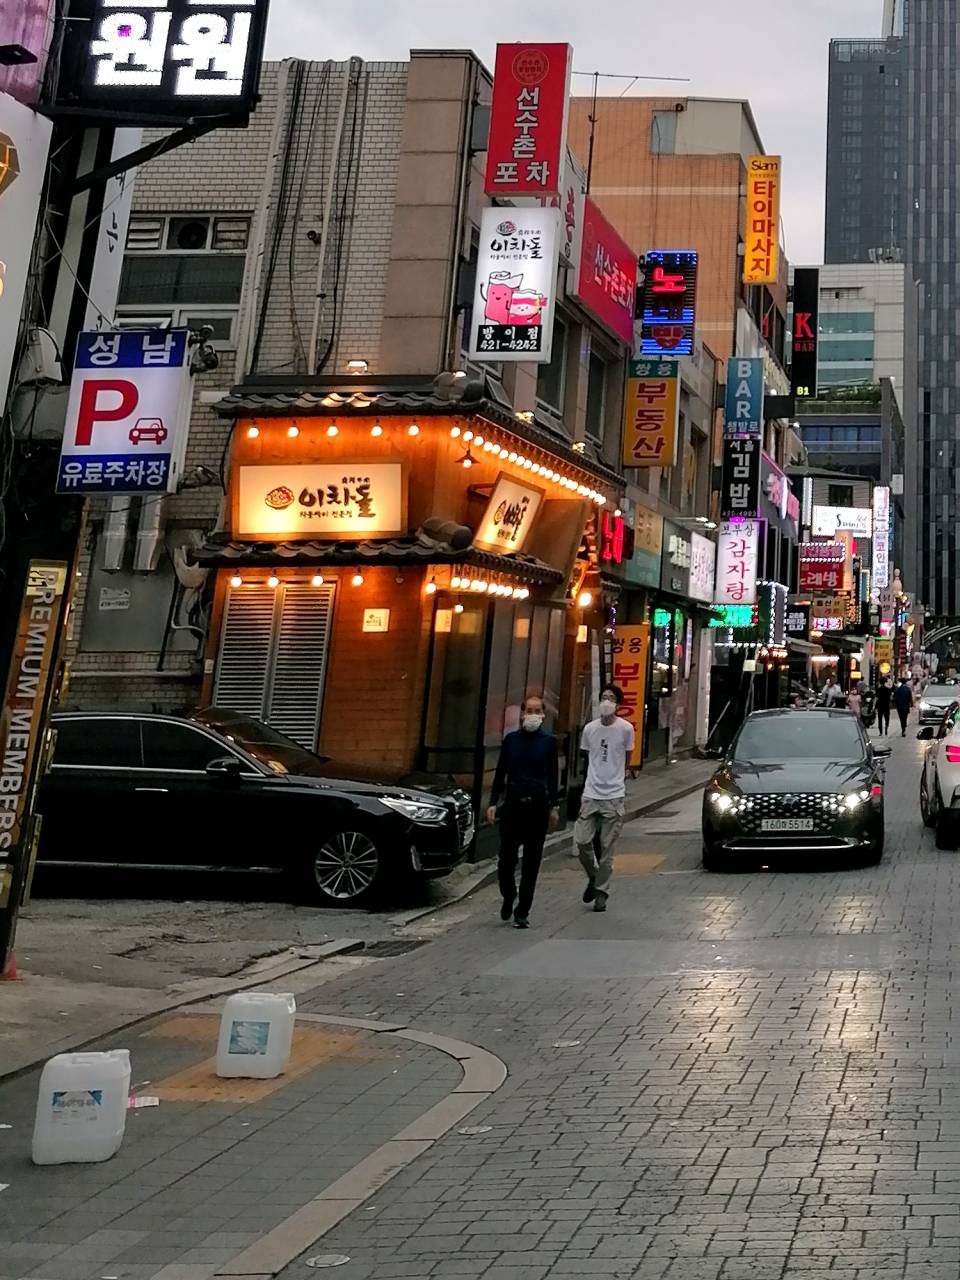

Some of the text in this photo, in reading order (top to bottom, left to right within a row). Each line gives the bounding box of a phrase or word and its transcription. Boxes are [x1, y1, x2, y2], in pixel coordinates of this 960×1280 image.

[511, 86, 540, 159] 선수촌
[494, 160, 550, 186] 포차
[751, 160, 778, 171] Siam
[751, 180, 776, 277] 타이마사지
[88, 334, 176, 366] 성남
[795, 313, 814, 338] K
[75, 379, 139, 446] P
[734, 360, 752, 419] BAR
[632, 382, 668, 460] 부동산
[731, 440, 754, 452] 서울
[62, 459, 167, 488] 유료주차장
[298, 484, 376, 518] 이차돌
[730, 454, 751, 509] 김밥
[726, 539, 751, 601] 감자탕
[14, 571, 61, 701] PREMIUM
